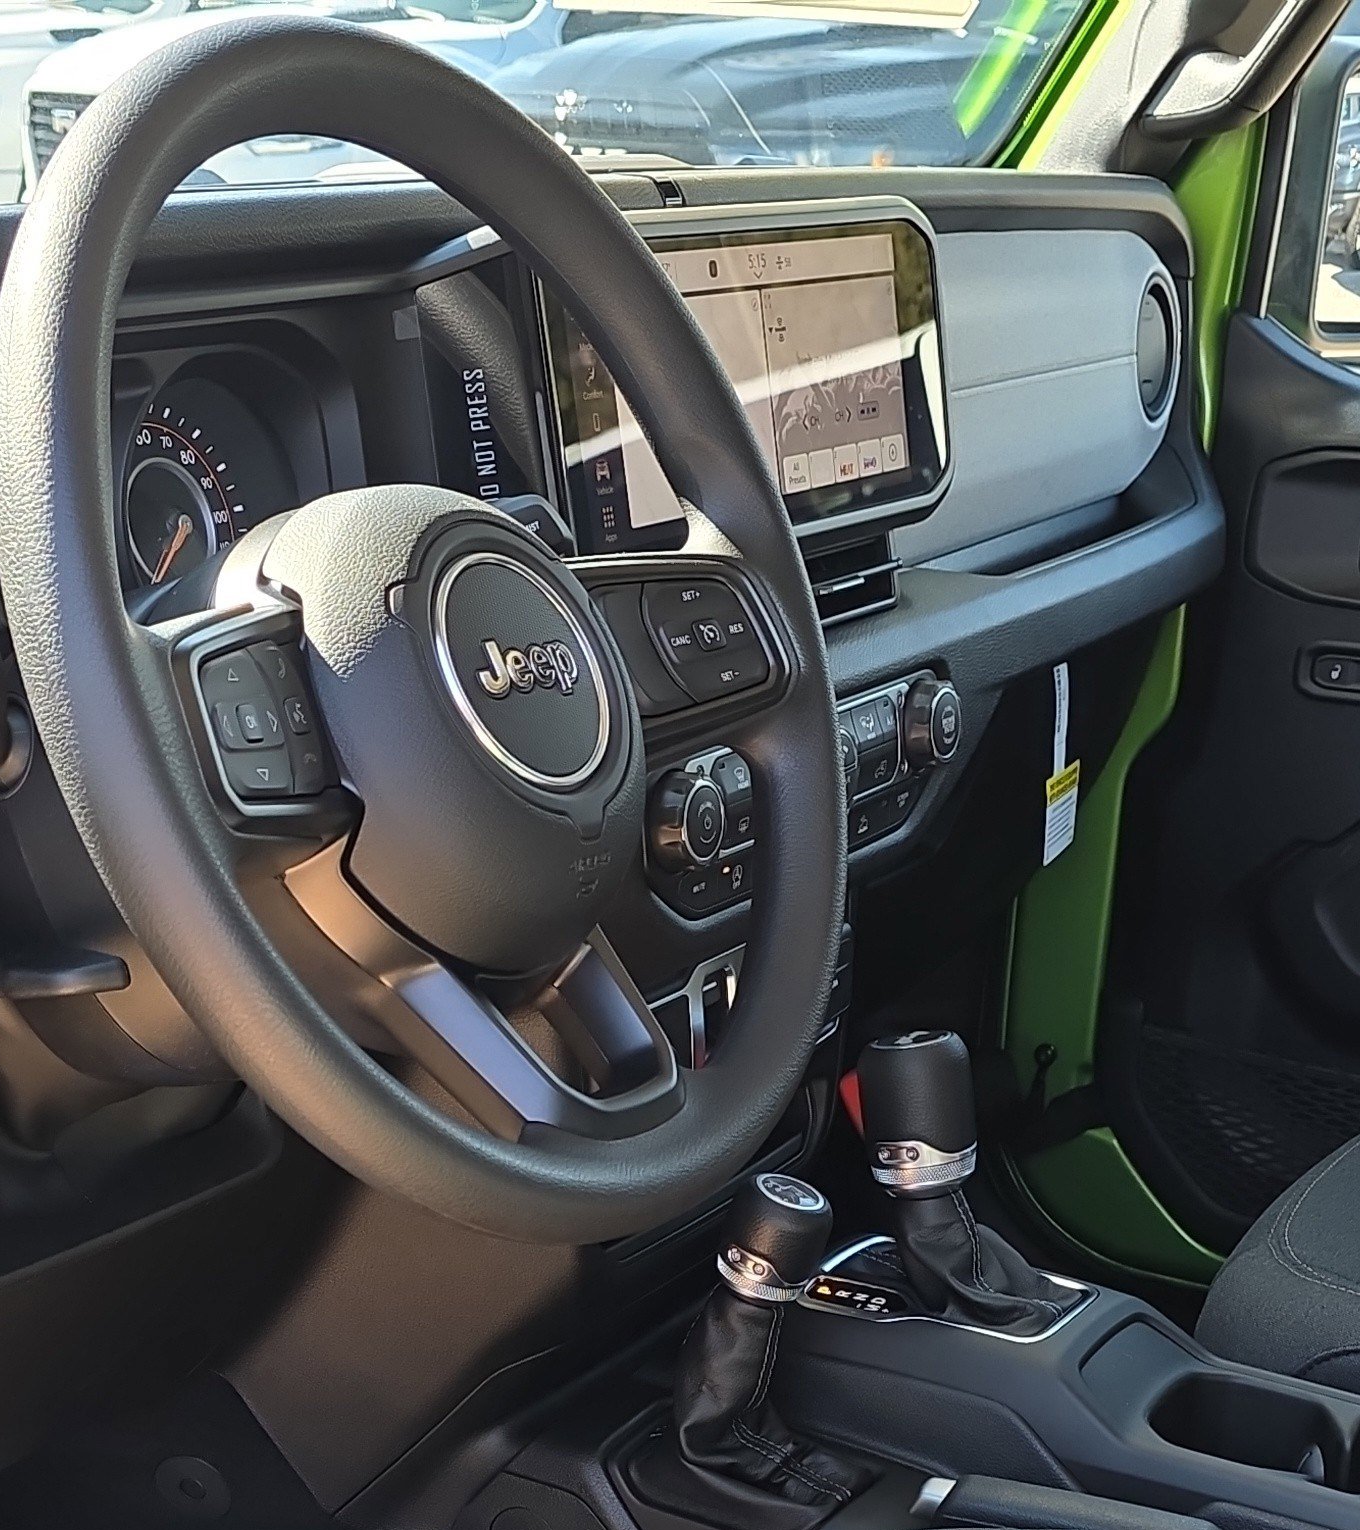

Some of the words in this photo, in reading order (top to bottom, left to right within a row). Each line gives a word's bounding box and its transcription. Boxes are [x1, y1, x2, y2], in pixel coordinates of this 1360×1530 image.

[747, 253, 767, 271] 5:15
[463, 368, 491, 432] PRESS
[160, 435, 173, 449] 70
[180, 449, 196, 465] 80
[472, 440, 498, 476] NOT
[200, 476, 213, 489] 90
[479, 483, 500, 501] O
[213, 510, 228, 524] 100
[525, 520, 540, 533] UST
[682, 590, 700, 602] SET+
[728, 622, 744, 634] RES
[671, 635, 692, 647] CANC
[477, 637, 578, 700] Jeep
[835, 1289, 852, 1298] R
[852, 1293, 870, 1301] N
[870, 1297, 887, 1306] D
